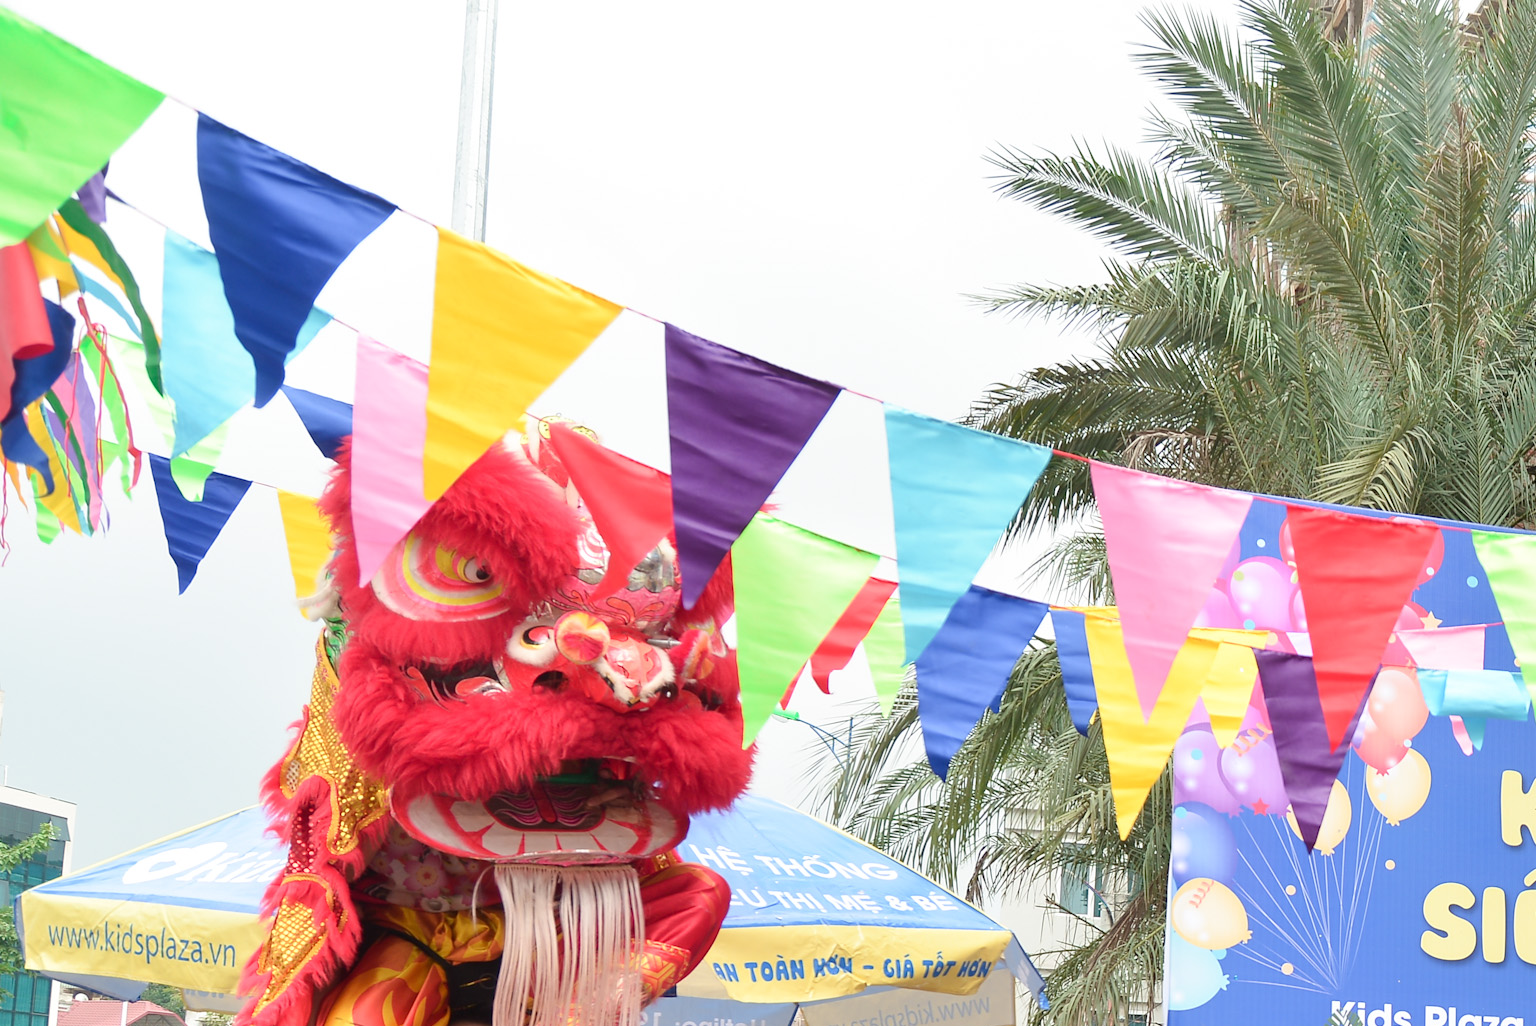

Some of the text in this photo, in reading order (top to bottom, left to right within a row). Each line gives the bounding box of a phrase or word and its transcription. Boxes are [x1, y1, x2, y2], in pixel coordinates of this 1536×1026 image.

[691, 844, 898, 881] HỆ THỐNG
[889, 896, 914, 912] &
[911, 891, 959, 912] BÉ
[48, 921, 236, 967] www.kidsplaza.vn
[713, 961, 739, 982] AN
[744, 955, 805, 982] TOÀN
[883, 956, 914, 979] GIÁ
